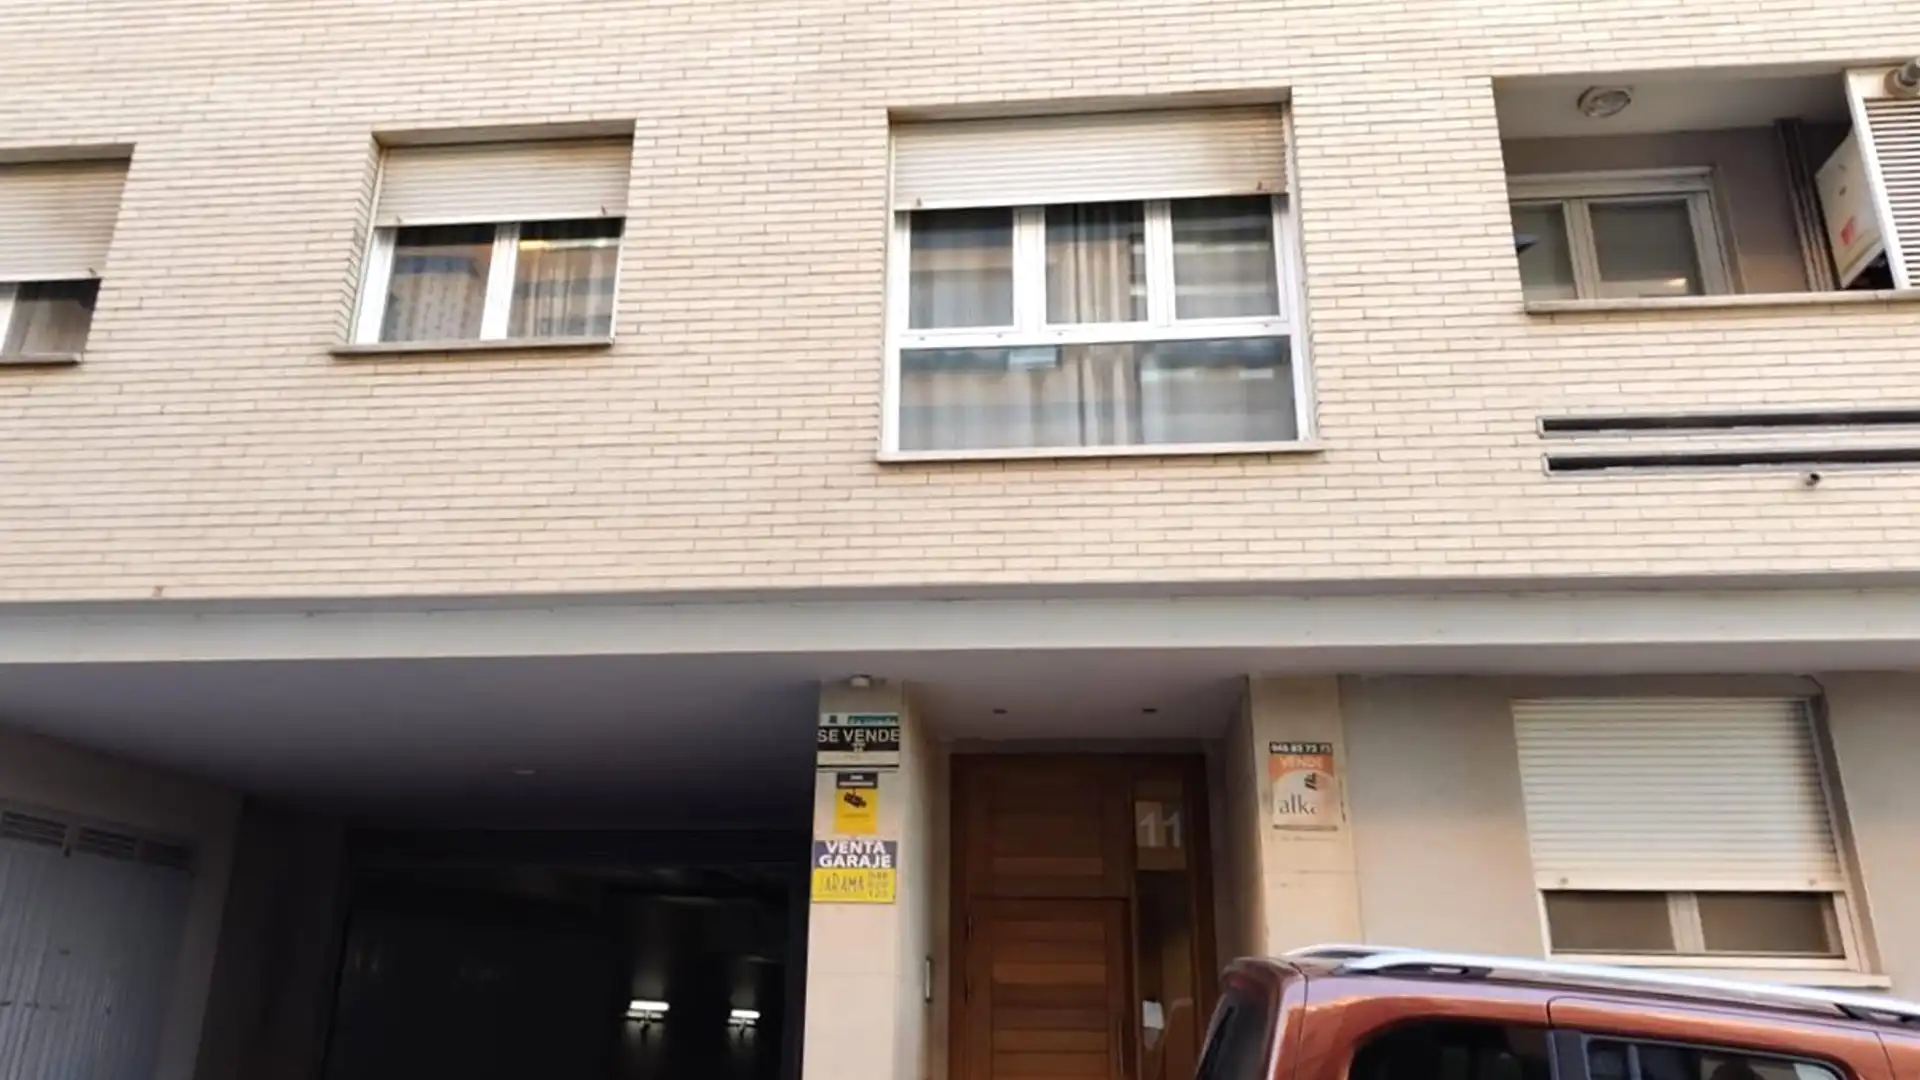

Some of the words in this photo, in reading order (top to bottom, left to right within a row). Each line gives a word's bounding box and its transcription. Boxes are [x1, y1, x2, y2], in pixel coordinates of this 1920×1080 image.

[817, 728, 839, 743] SE
[842, 728, 900, 743] VENDE
[1140, 811, 1180, 847] 11
[825, 840, 886, 854] VENTA
[819, 854, 892, 868] GARAJE
